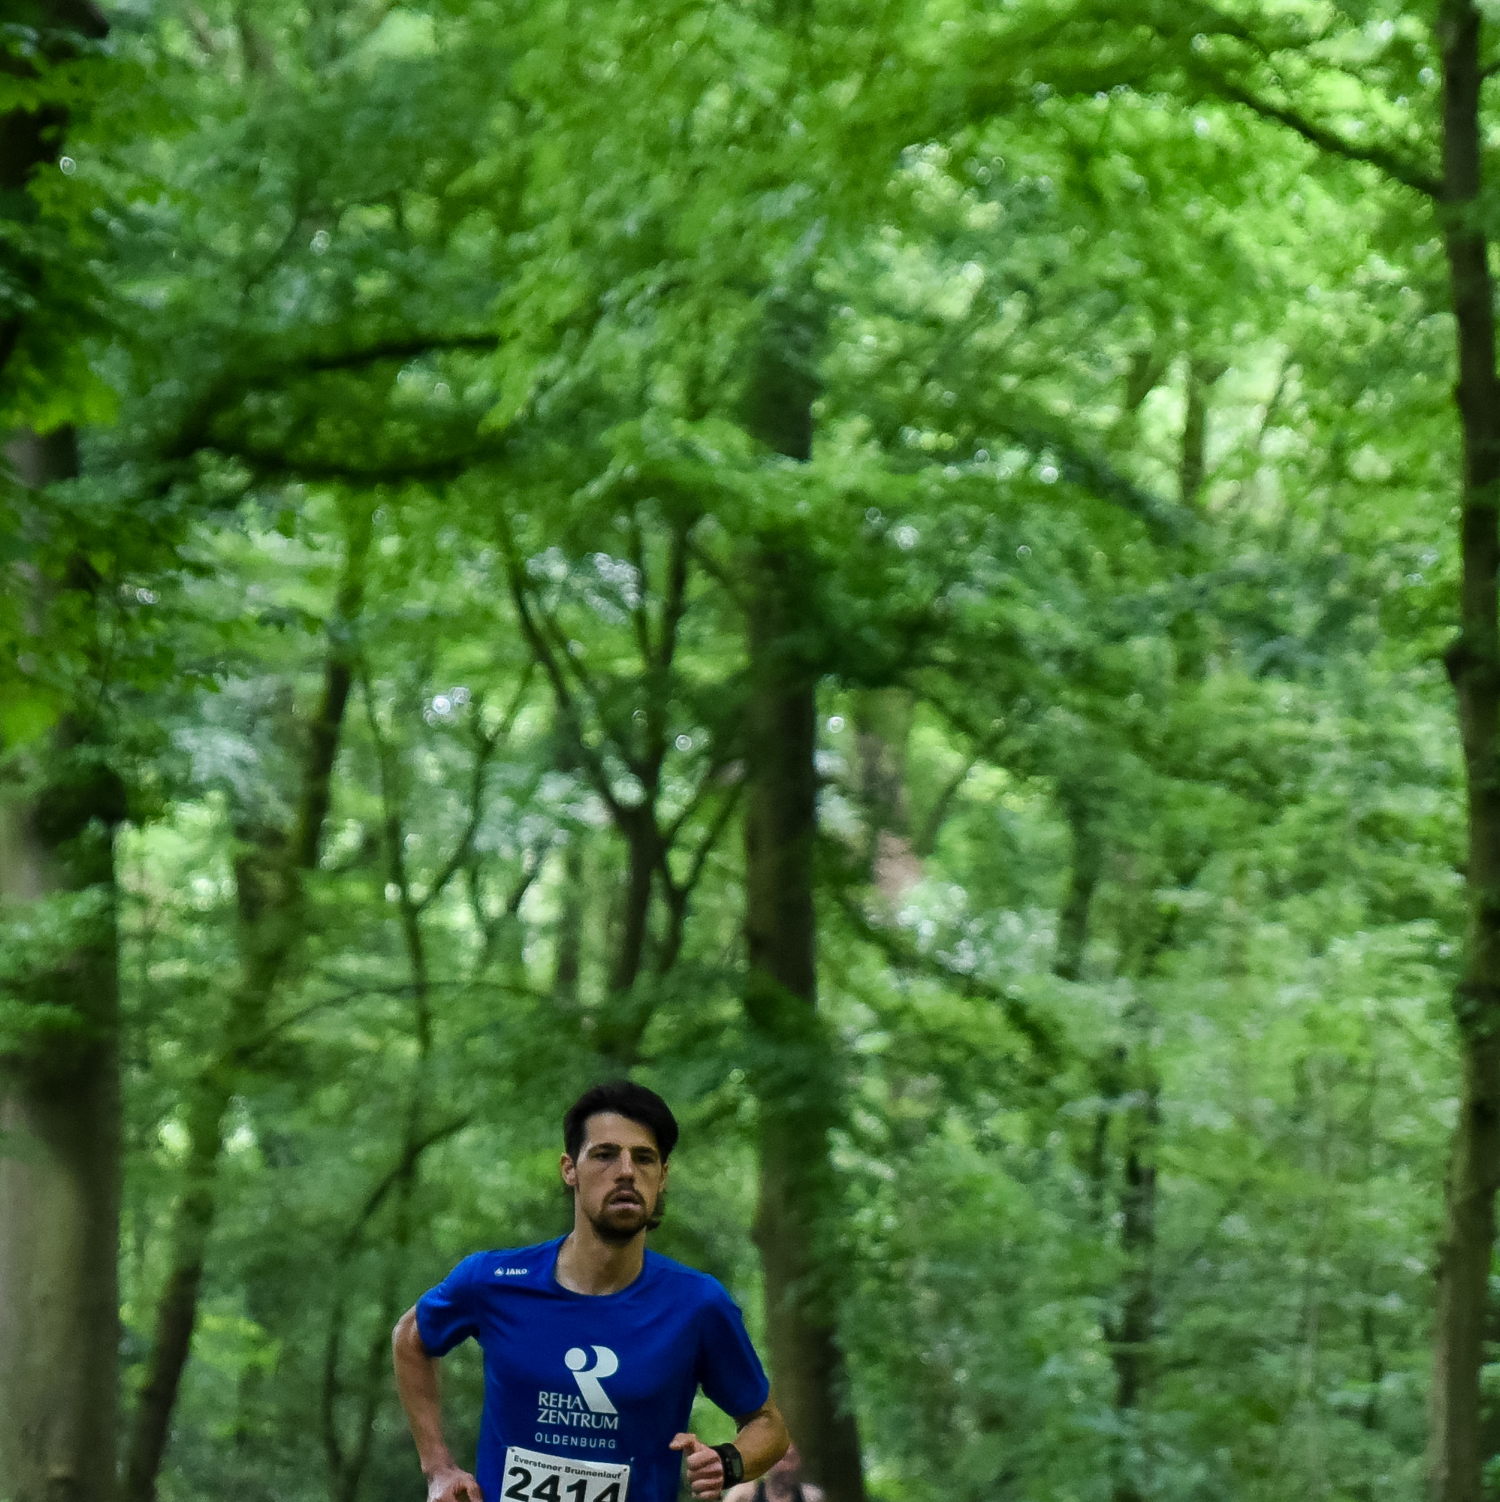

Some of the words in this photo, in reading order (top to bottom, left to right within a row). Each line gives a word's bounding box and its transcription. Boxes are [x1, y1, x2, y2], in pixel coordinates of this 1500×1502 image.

[505, 1268, 528, 1276] JAKO
[538, 1391, 585, 1411] REHA
[536, 1408, 619, 1430] ZENTRUM
[534, 1432, 617, 1449] OLDENBURG
[564, 1466, 622, 1480] Brunnenlauf
